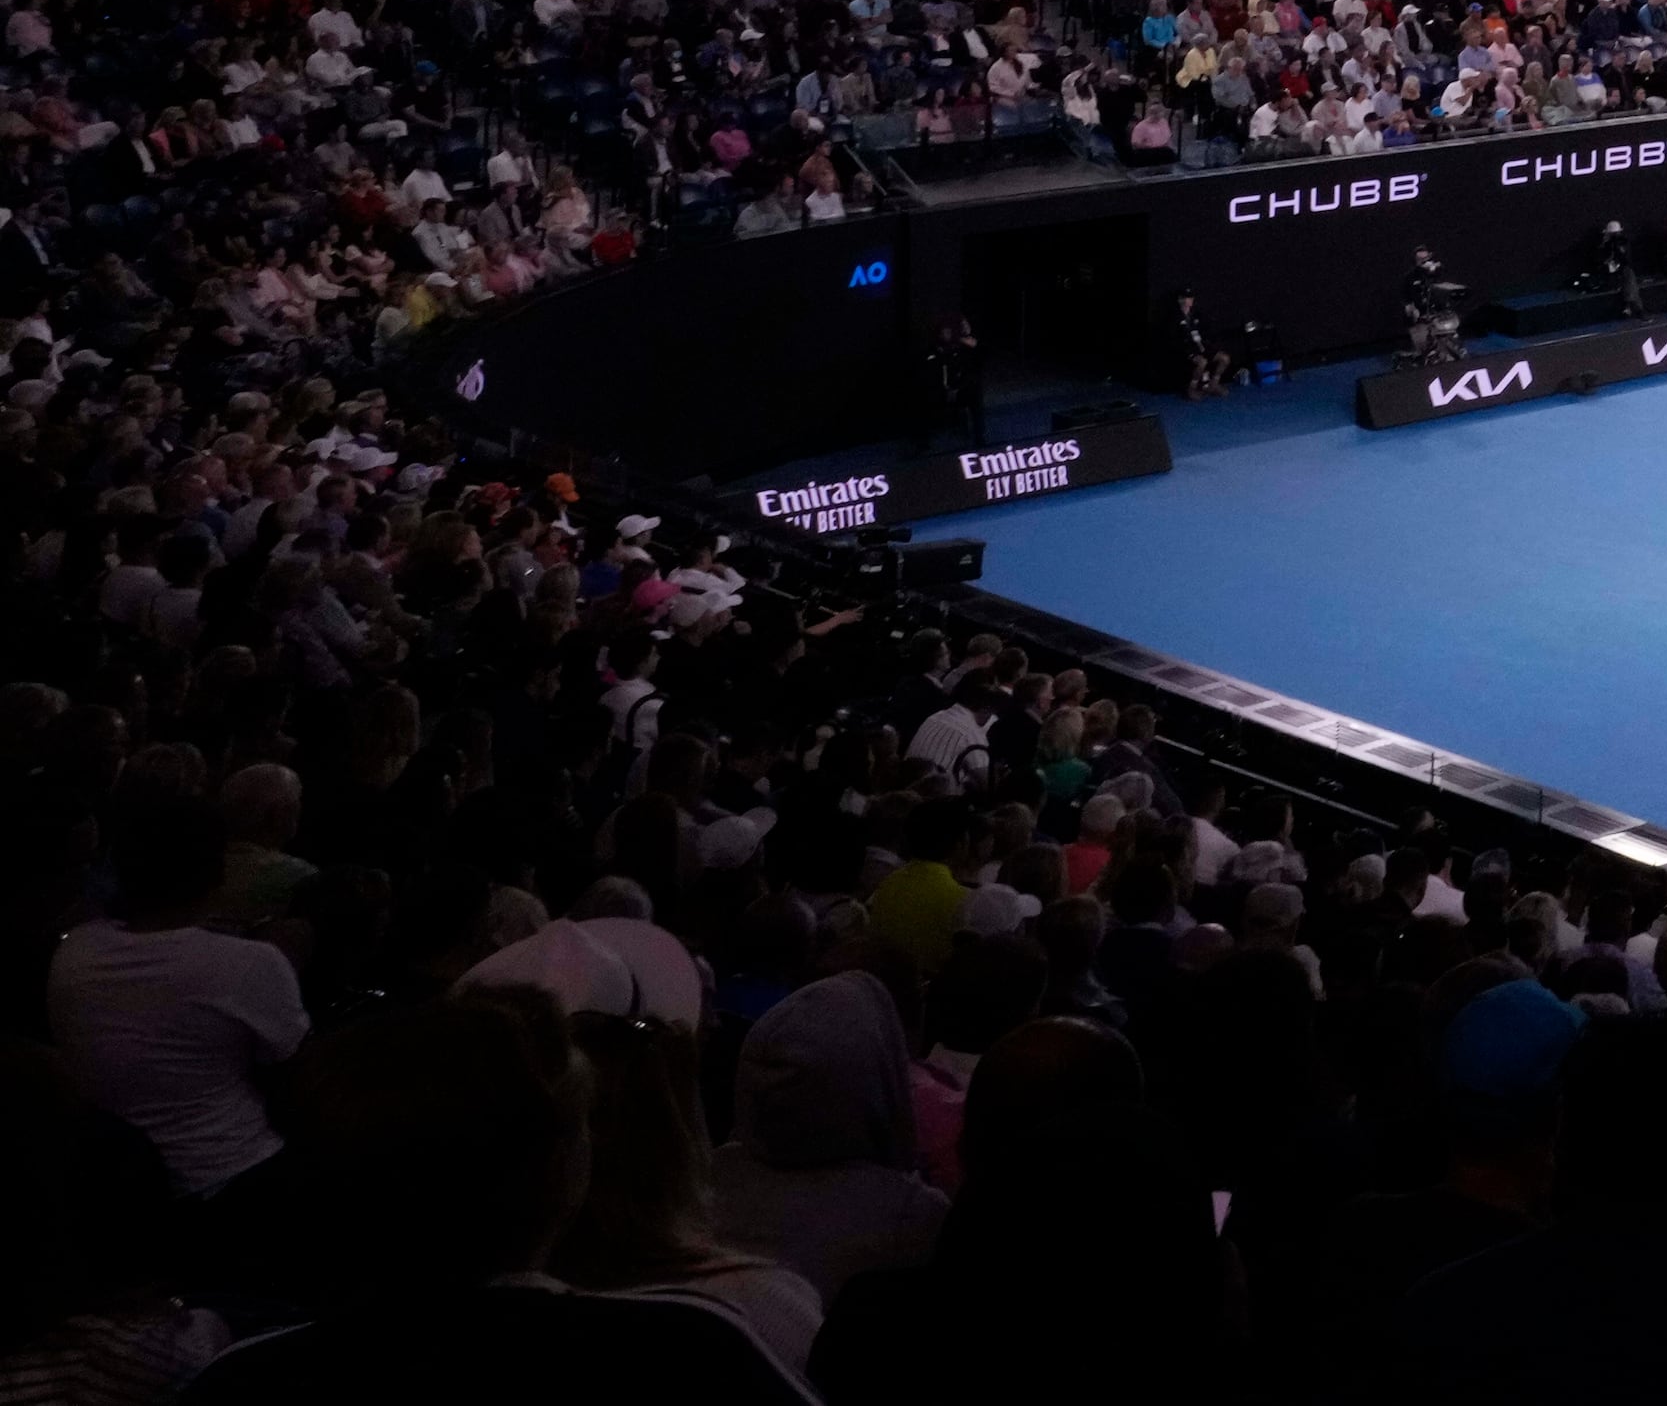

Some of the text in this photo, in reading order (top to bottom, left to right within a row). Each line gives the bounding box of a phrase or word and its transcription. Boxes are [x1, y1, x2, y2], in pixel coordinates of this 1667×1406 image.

[848, 261, 888, 288] AO
[1428, 360, 1534, 408] KIA
[959, 439, 1081, 480] Emirates
[757, 474, 890, 518] Emirates
[985, 465, 1069, 500] FLY BETTER
[817, 502, 876, 534] BETTER
